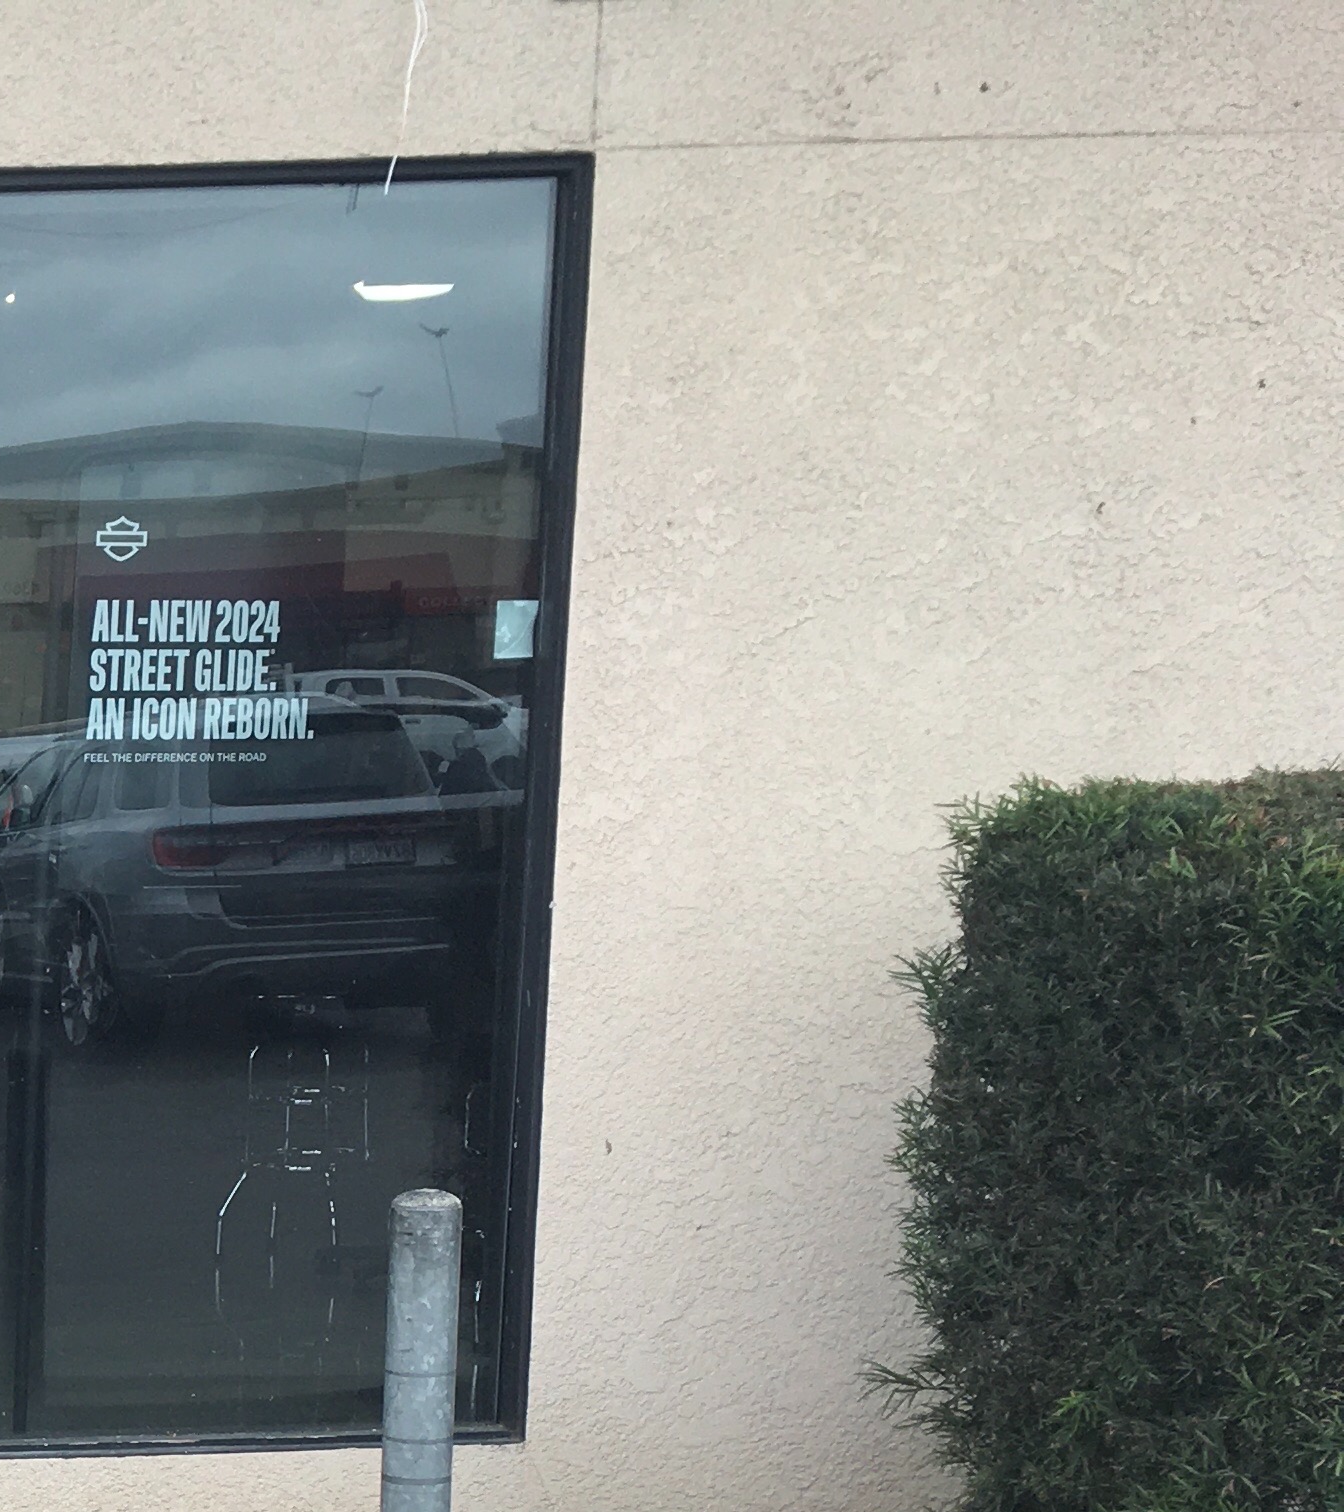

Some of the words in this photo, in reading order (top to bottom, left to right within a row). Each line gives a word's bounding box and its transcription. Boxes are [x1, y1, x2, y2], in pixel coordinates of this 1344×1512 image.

[91, 599, 212, 643] ALL-NEW
[215, 600, 281, 643] 2024
[89, 649, 190, 692] STREET
[86, 697, 125, 740] AN
[132, 697, 197, 740] ICON
[203, 697, 315, 740] REBORN.
[83, 753, 110, 763] FEEL
[112, 753, 132, 762] THE
[134, 752, 197, 762] DIFFERENCE
[199, 752, 215, 762] ON
[217, 752, 236, 762] THE
[238, 751, 267, 762] ROAD
